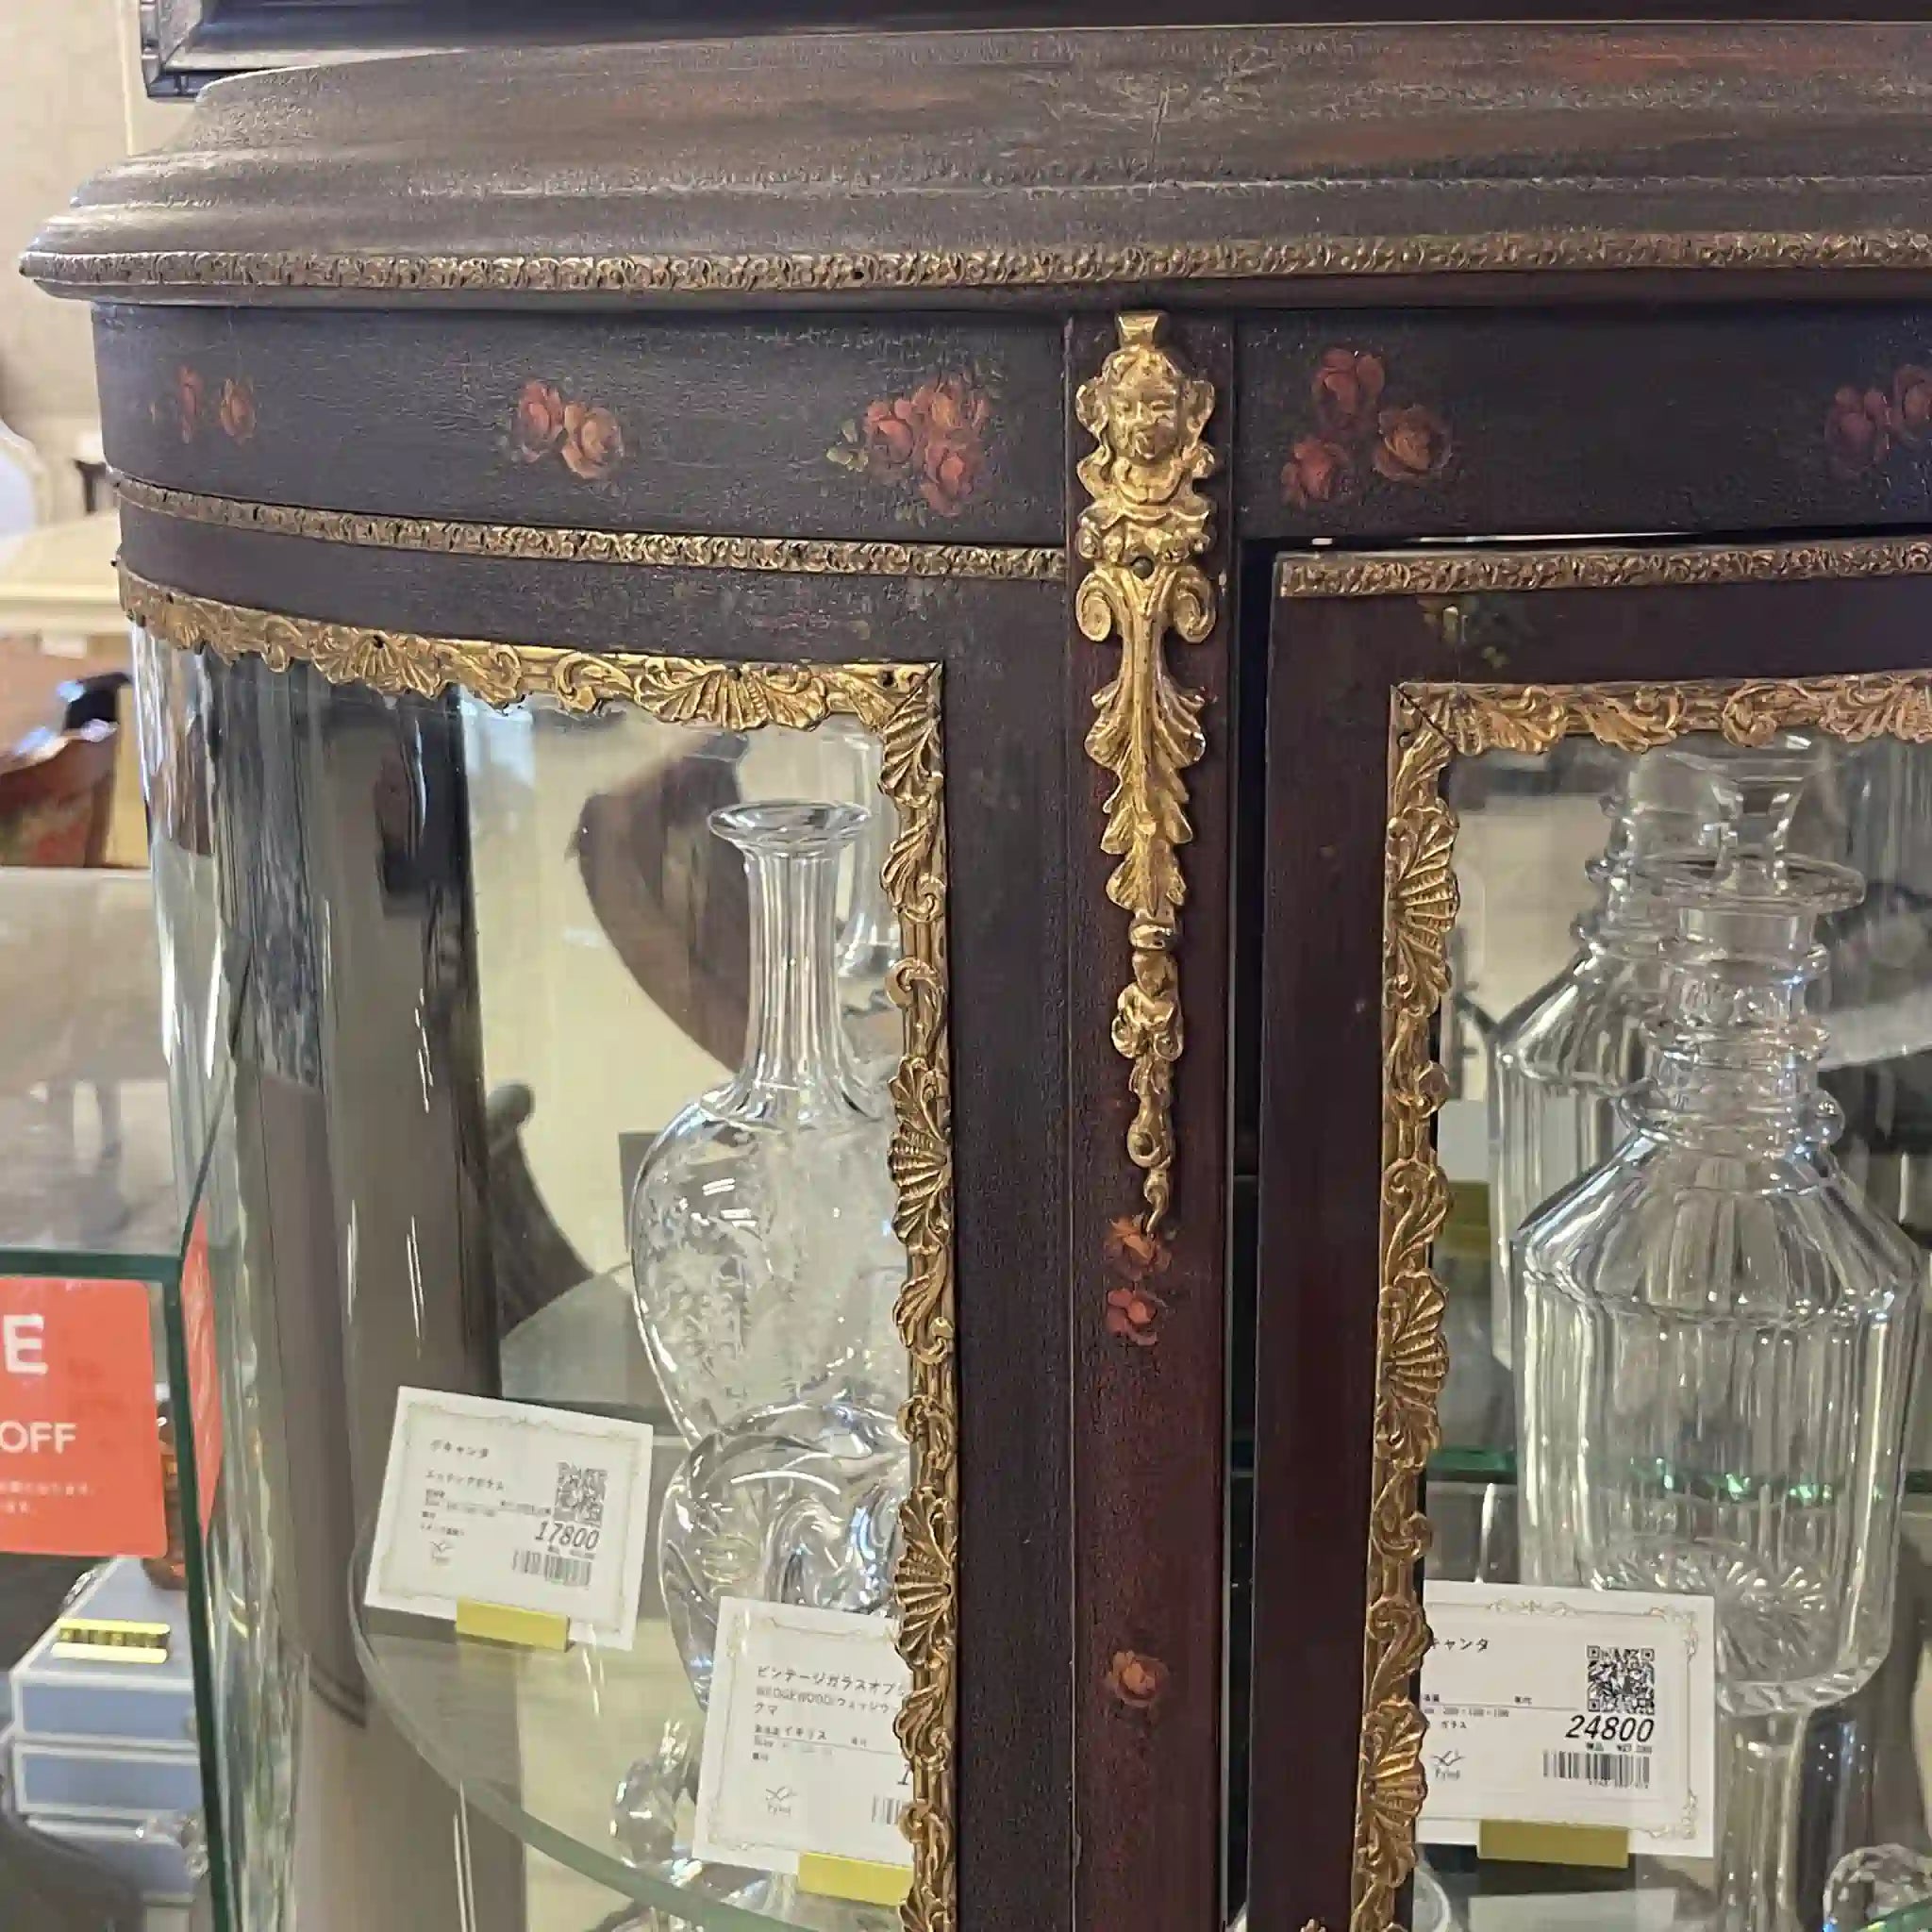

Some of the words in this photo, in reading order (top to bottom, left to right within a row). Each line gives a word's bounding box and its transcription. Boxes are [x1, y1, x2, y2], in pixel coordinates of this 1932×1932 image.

[3, 1313, 48, 1375] E
[0, 1421, 76, 1455] OFF
[535, 1520, 599, 1550] 17800
[1565, 1714, 1654, 1742] 24800
